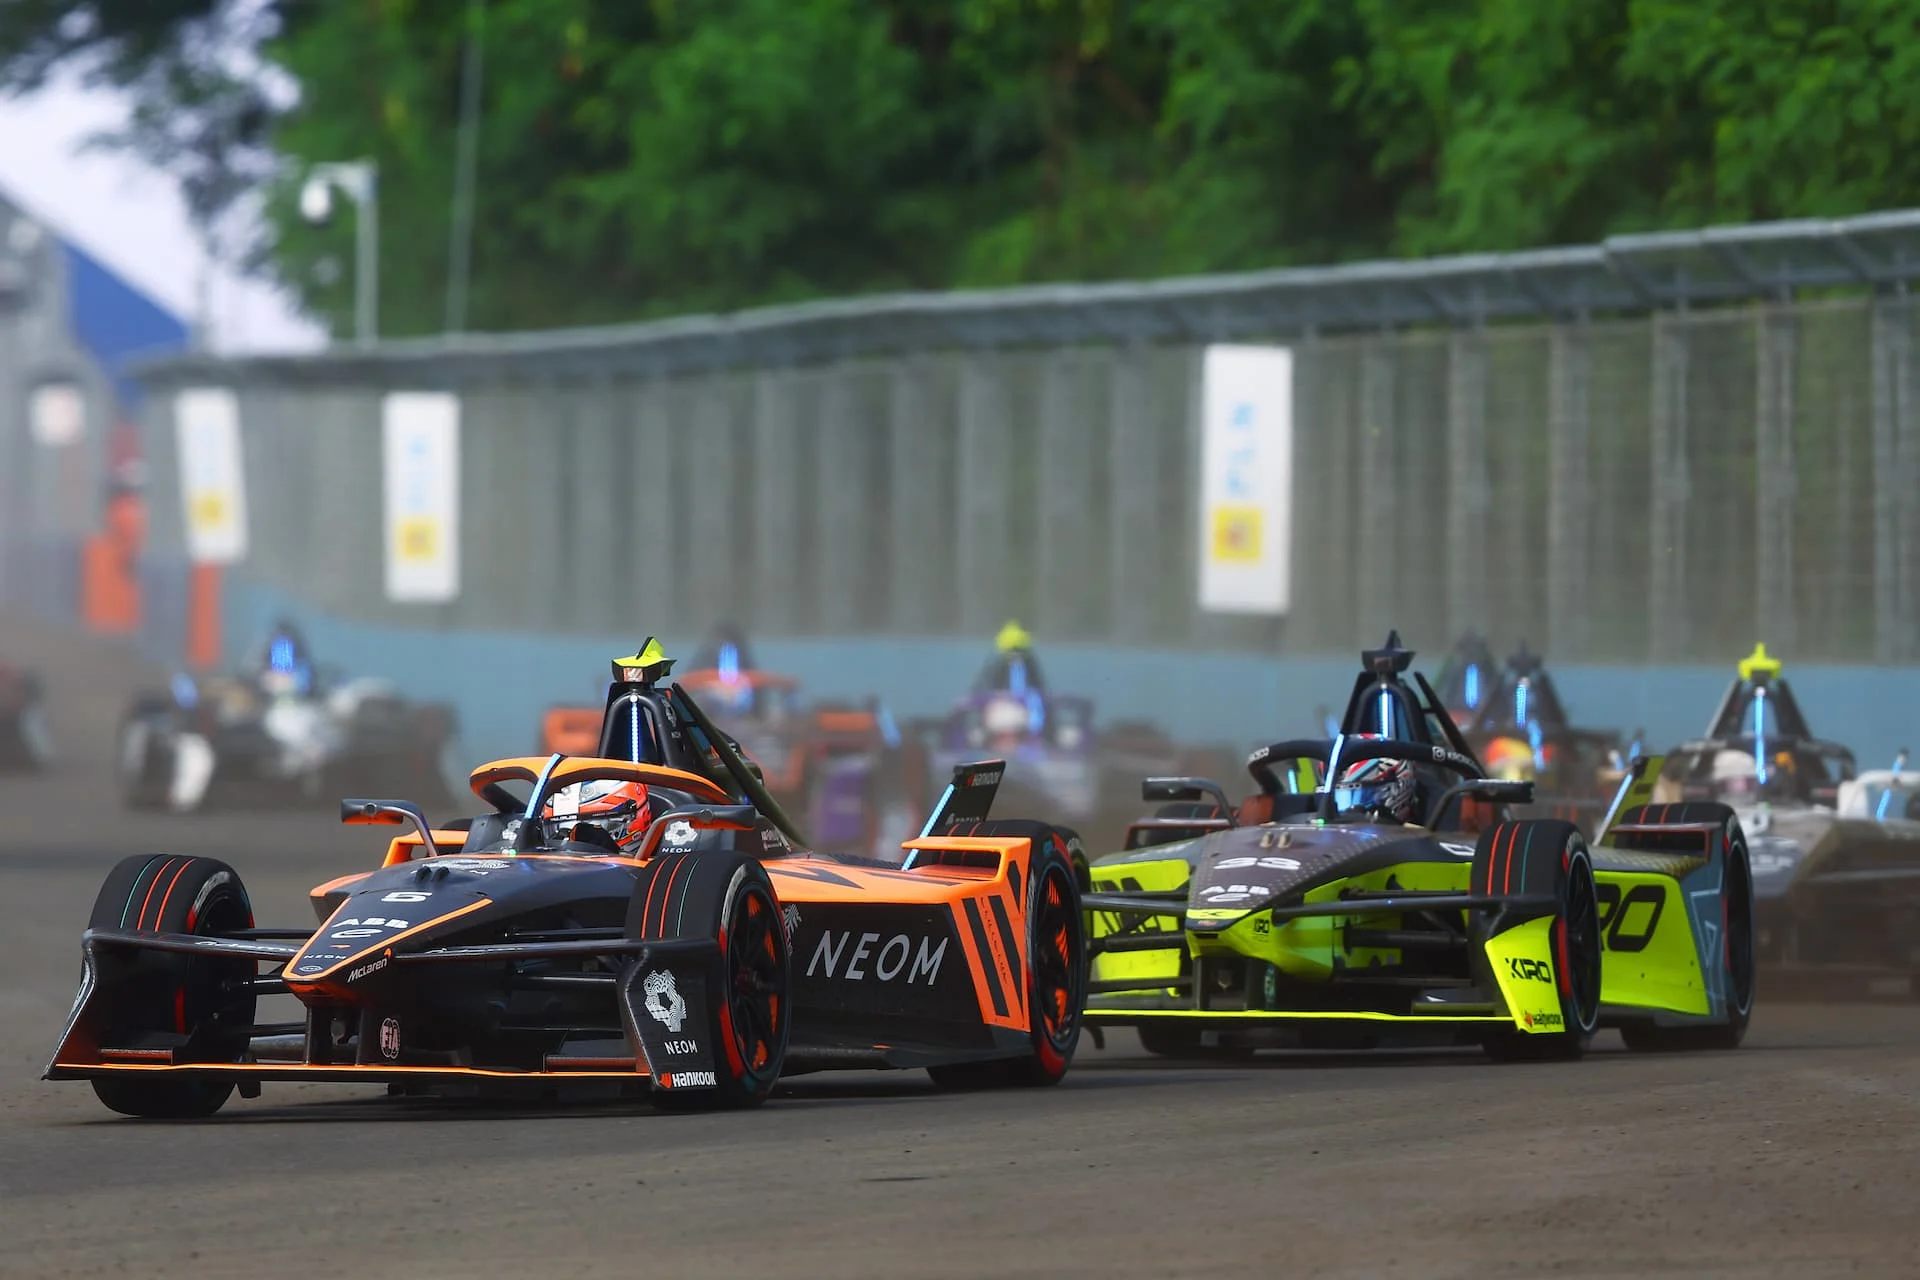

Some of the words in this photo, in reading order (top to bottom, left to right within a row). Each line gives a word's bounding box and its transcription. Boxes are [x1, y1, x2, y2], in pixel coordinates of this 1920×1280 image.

[380, 891, 433, 903] 5
[1199, 884, 1270, 896] ABB
[332, 917, 409, 929] ABB
[303, 953, 348, 961] NEOM
[805, 929, 949, 986] NEOM
[347, 958, 388, 983] McLaren
[1505, 958, 1551, 983] KIRO
[664, 1039, 699, 1055] NEOM
